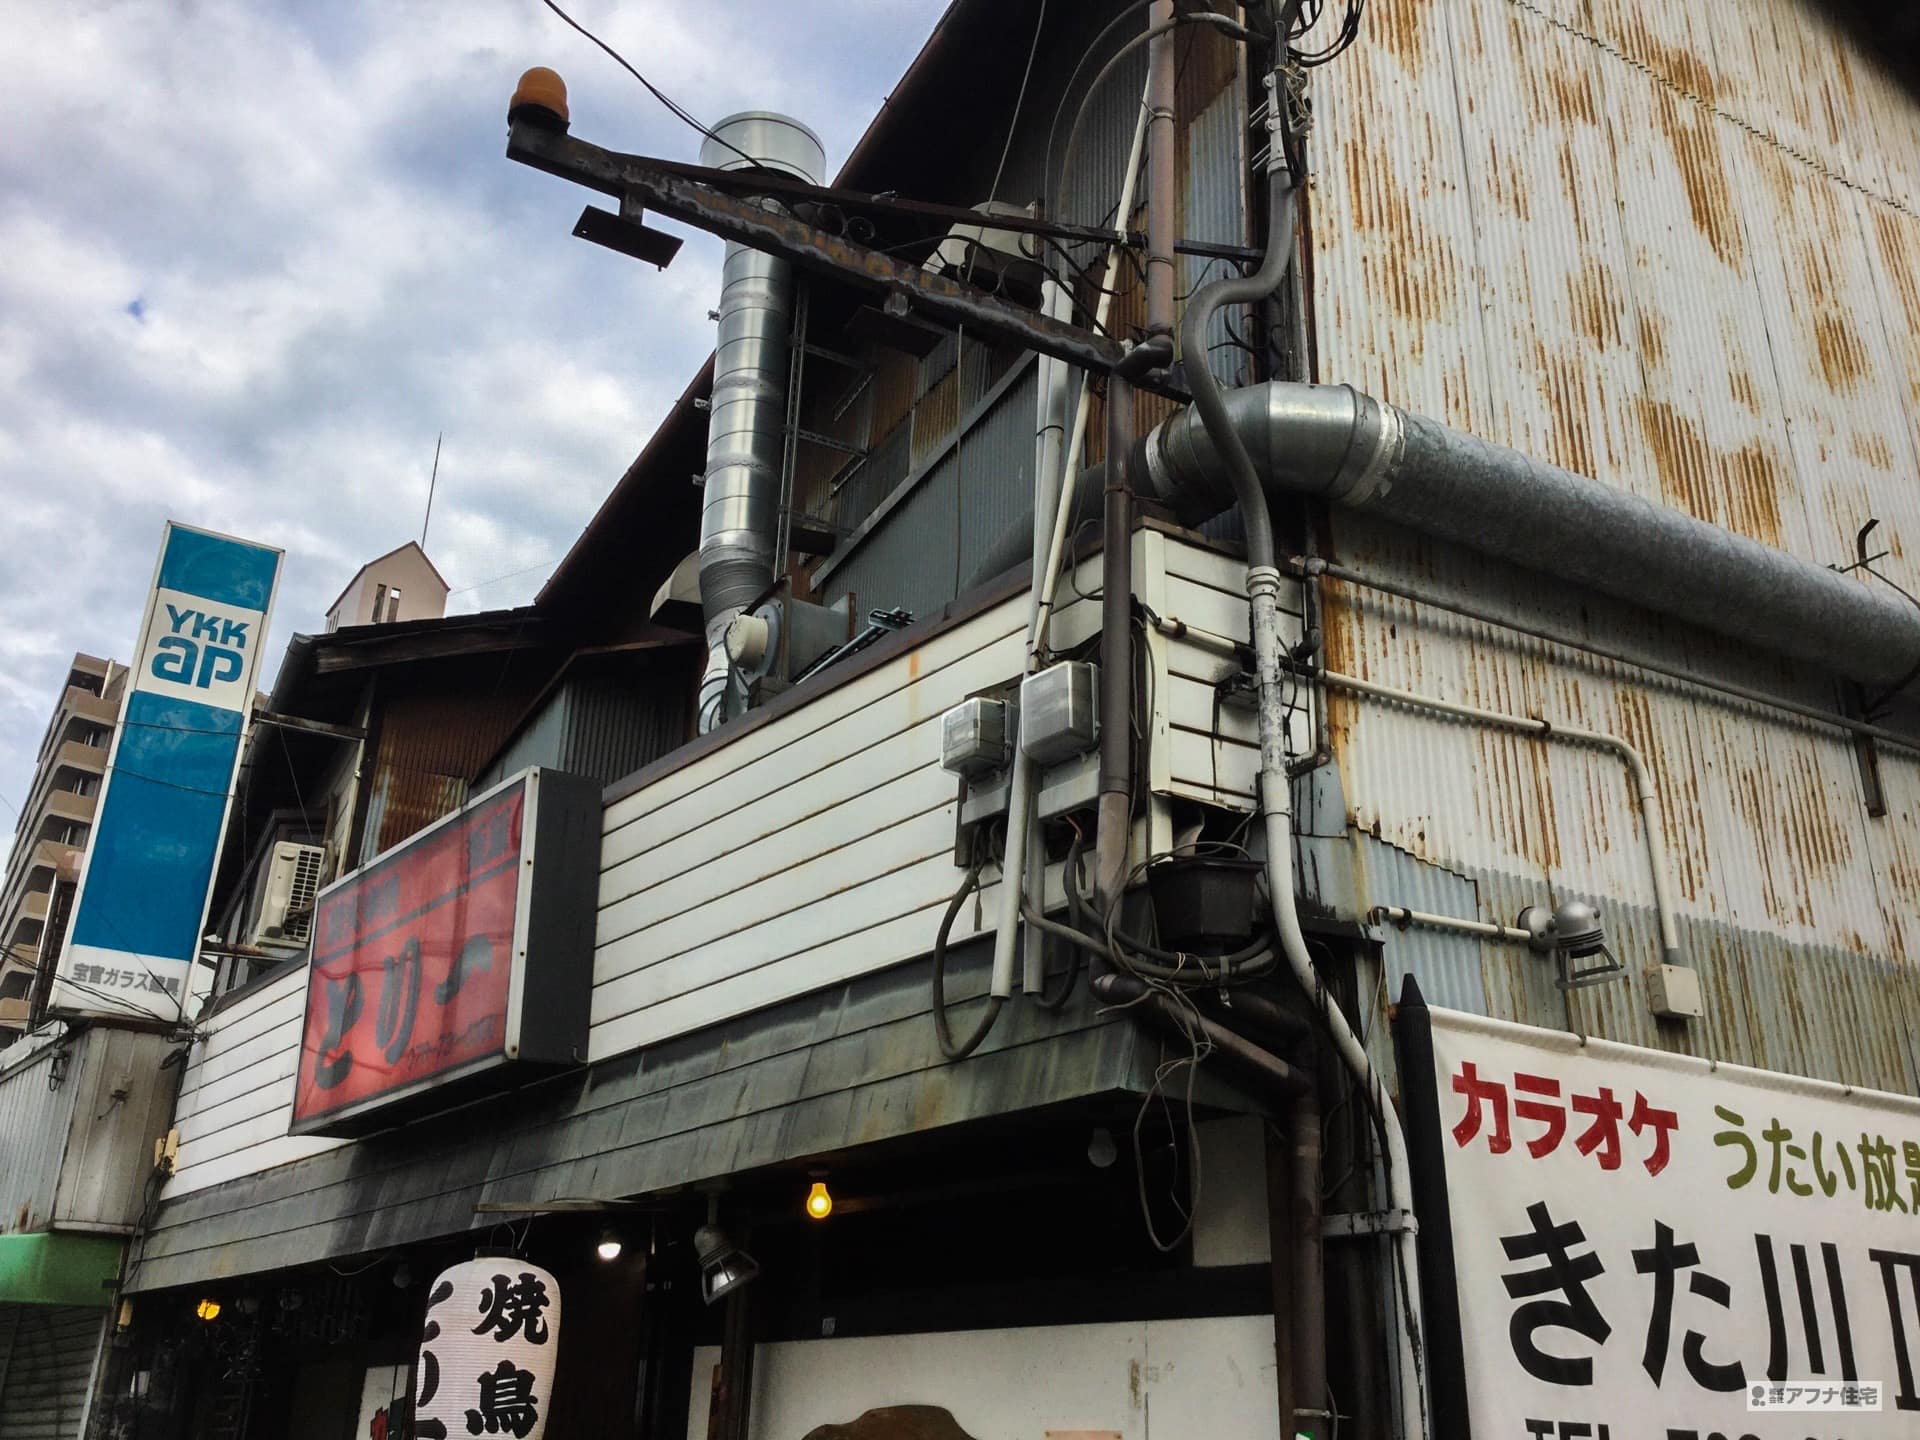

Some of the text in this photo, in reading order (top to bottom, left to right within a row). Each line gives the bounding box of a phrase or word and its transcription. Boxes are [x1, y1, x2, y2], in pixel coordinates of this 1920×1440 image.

[151, 636, 243, 690] ap
[166, 603, 250, 649] YKK
[1452, 1061, 1679, 1177] カラオケ
[464, 1272, 550, 1439] 焼鳥
